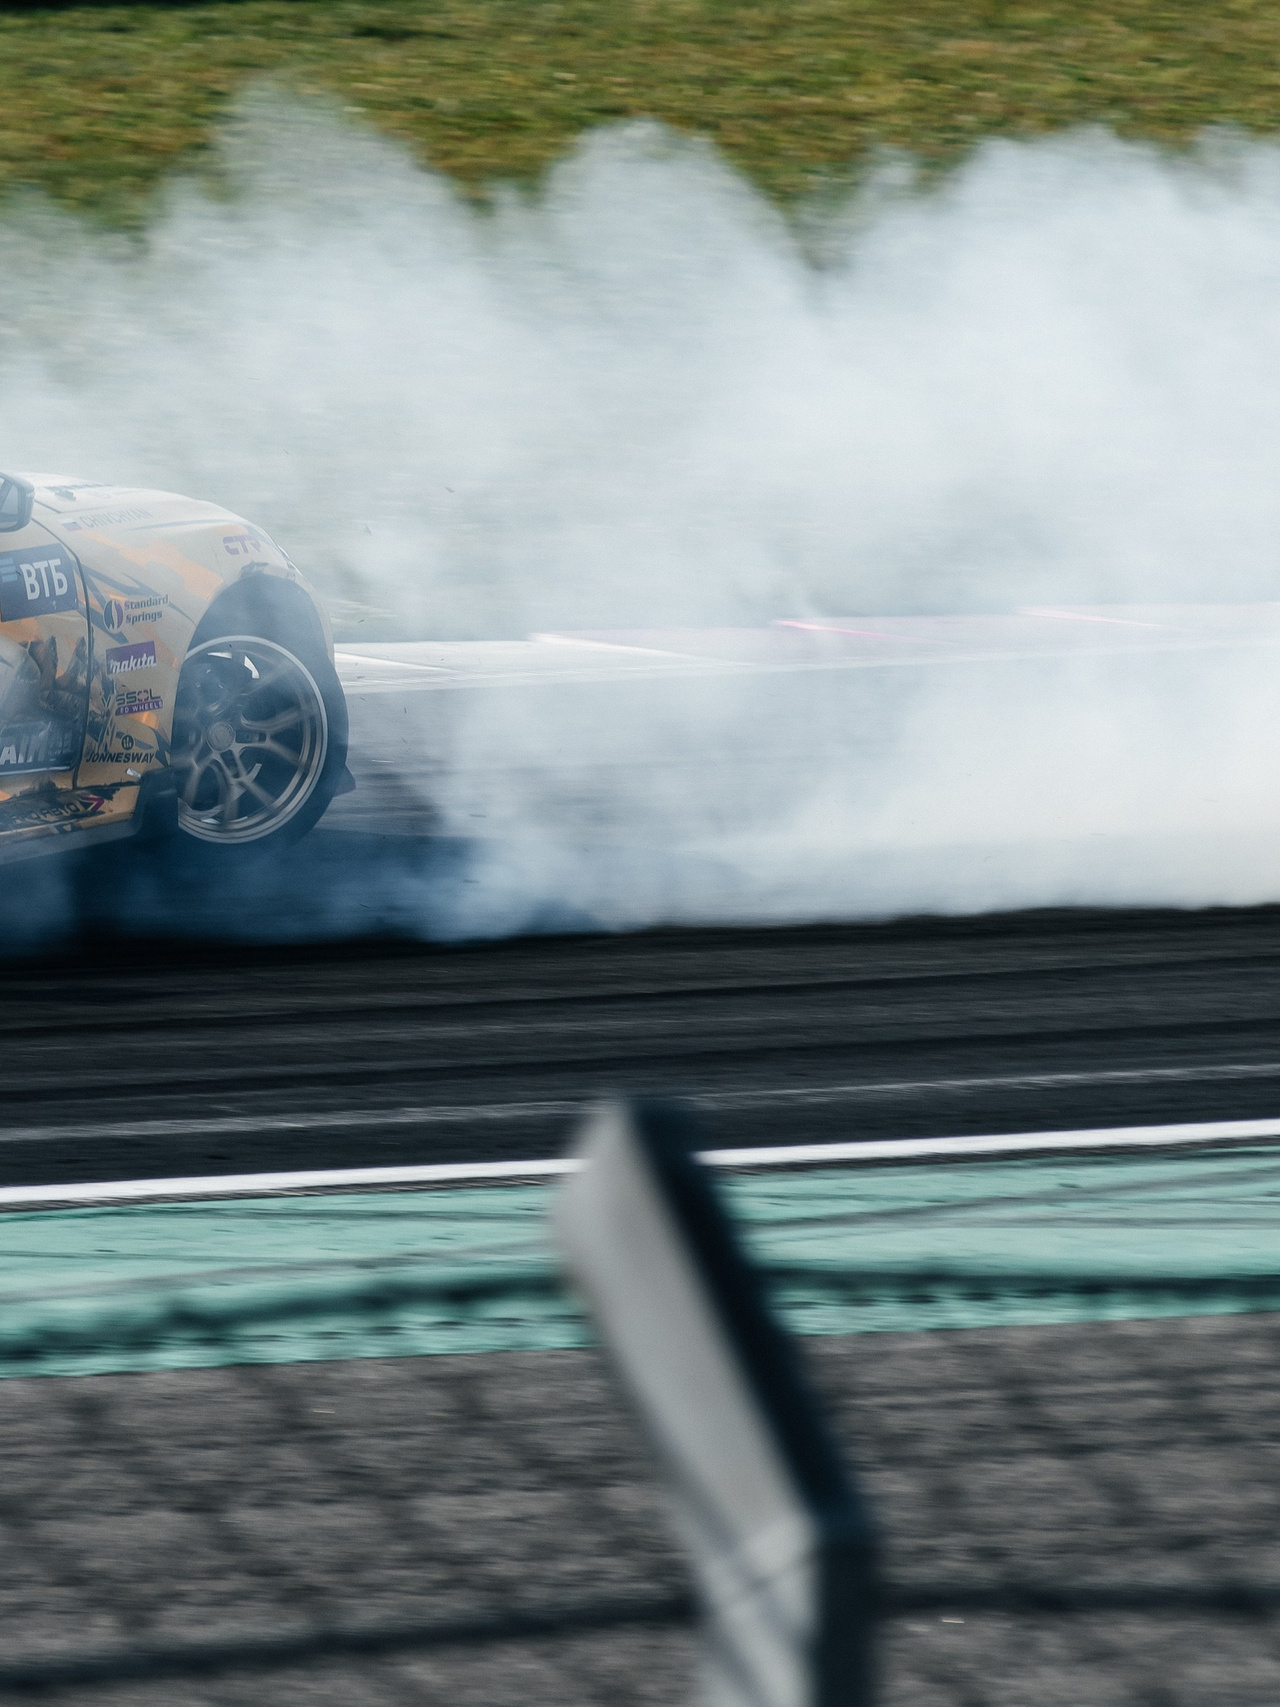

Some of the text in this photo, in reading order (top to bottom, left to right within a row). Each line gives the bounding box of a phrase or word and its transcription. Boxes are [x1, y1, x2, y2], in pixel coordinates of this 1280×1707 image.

[20, 558, 68, 601] ВТБ
[124, 594, 169, 610] Standard
[125, 610, 163, 625] Springs
[101, 688, 161, 707] VSSOL
[86, 752, 156, 764] JONNESWAY
